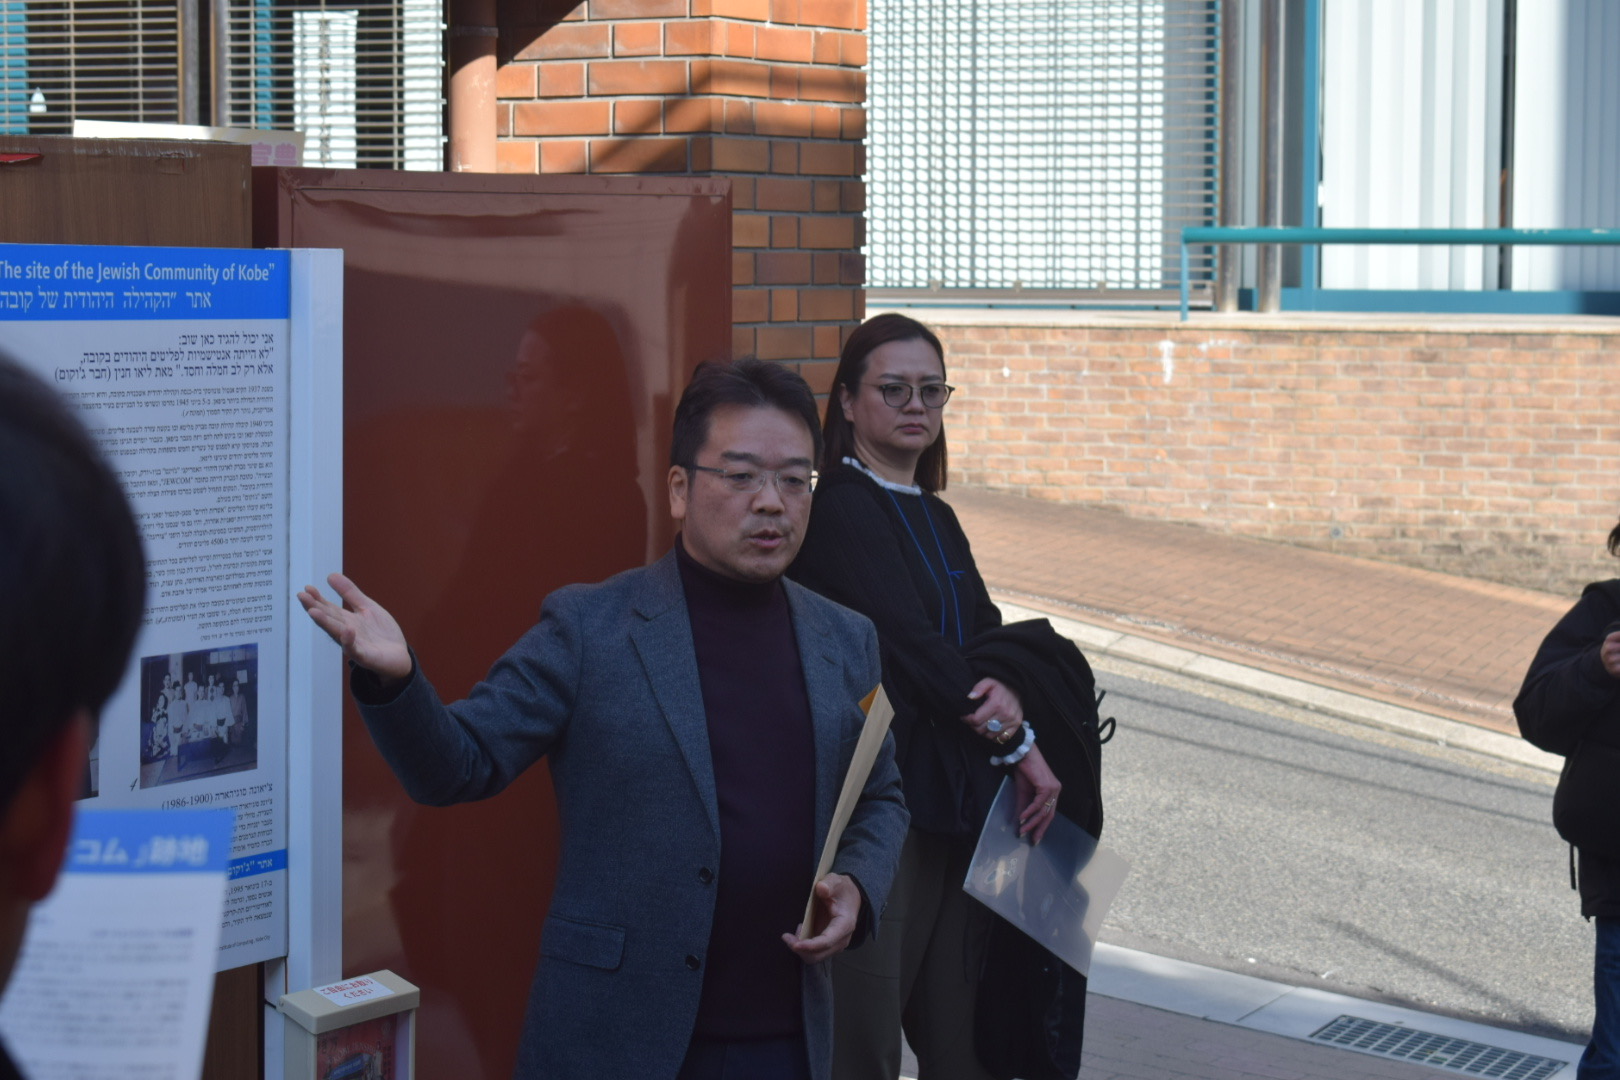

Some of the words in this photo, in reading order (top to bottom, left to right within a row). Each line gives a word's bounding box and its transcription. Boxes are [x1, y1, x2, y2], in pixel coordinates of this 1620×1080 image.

[26, 260, 50, 279] site
[54, 260, 69, 280] of
[71, 261, 94, 280] the
[96, 262, 140, 283] Jewish
[144, 263, 219, 285] Community
[222, 262, 235, 280] of
[38, 285, 58, 308] של
[63, 292, 114, 308] היהודית
[186, 292, 212, 308] אתר
[179, 334, 198, 346] שוב:
[201, 334, 214, 348] כאן
[218, 331, 240, 345] להגיד
[243, 331, 259, 344] יכול
[262, 334, 274, 344] אני
[80, 352, 110, 366] בקובה,
[114, 351, 147, 362] היהודים
[151, 348, 184, 362] לפליטים
[187, 350, 230, 361] אנטישמיות
[234, 350, 256, 360] הייתה
[258, 346, 274, 359] "לא
[89, 366, 111, 382] (חבר
[134, 364, 151, 378] ליאו
[155, 366, 173, 378] מאת
[206, 363, 228, 376] חמלה
[231, 362, 241, 375] לב
[244, 365, 255, 377] רק
[258, 362, 274, 374] אלא
[114, 368, 130, 382] חנין
[257, 858, 272, 869] אתר
[343, 988, 374, 999] ください
